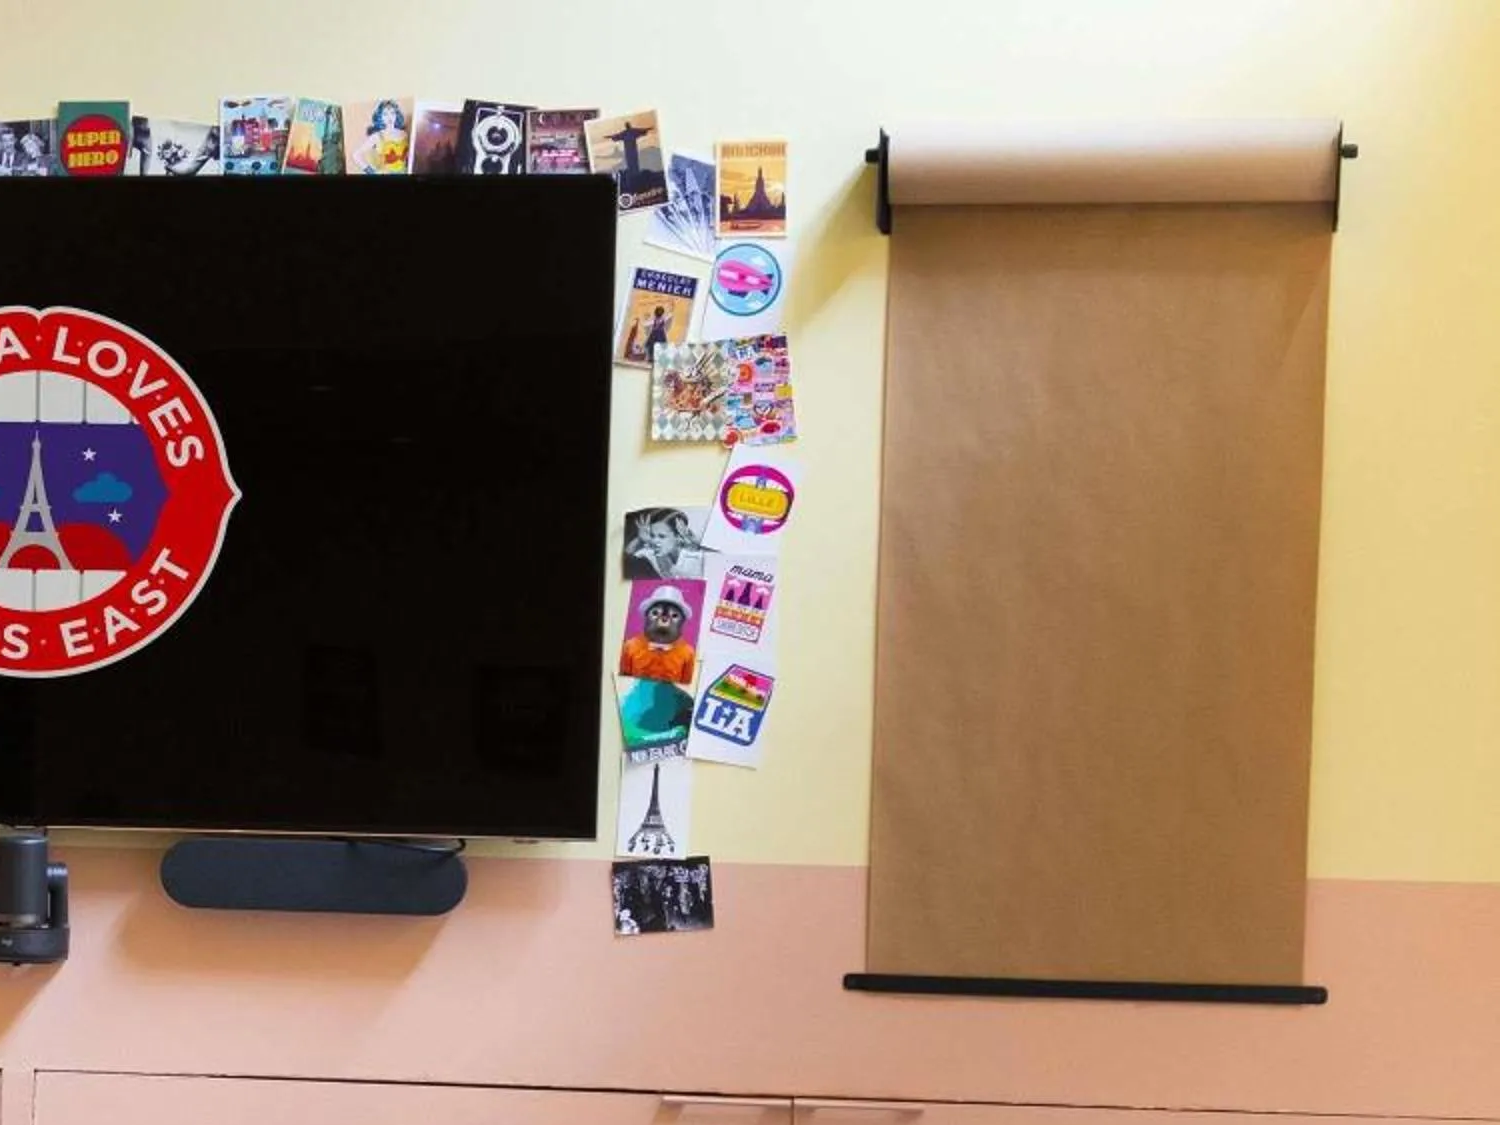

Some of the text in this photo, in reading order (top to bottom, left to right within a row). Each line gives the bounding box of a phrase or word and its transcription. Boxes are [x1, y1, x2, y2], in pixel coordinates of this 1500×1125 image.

[67, 129, 120, 148] SUPER
[68, 150, 119, 168] HERO
[52, 325, 204, 468] LOVES
[729, 564, 774, 583] mama
[59, 548, 191, 658] EAST
